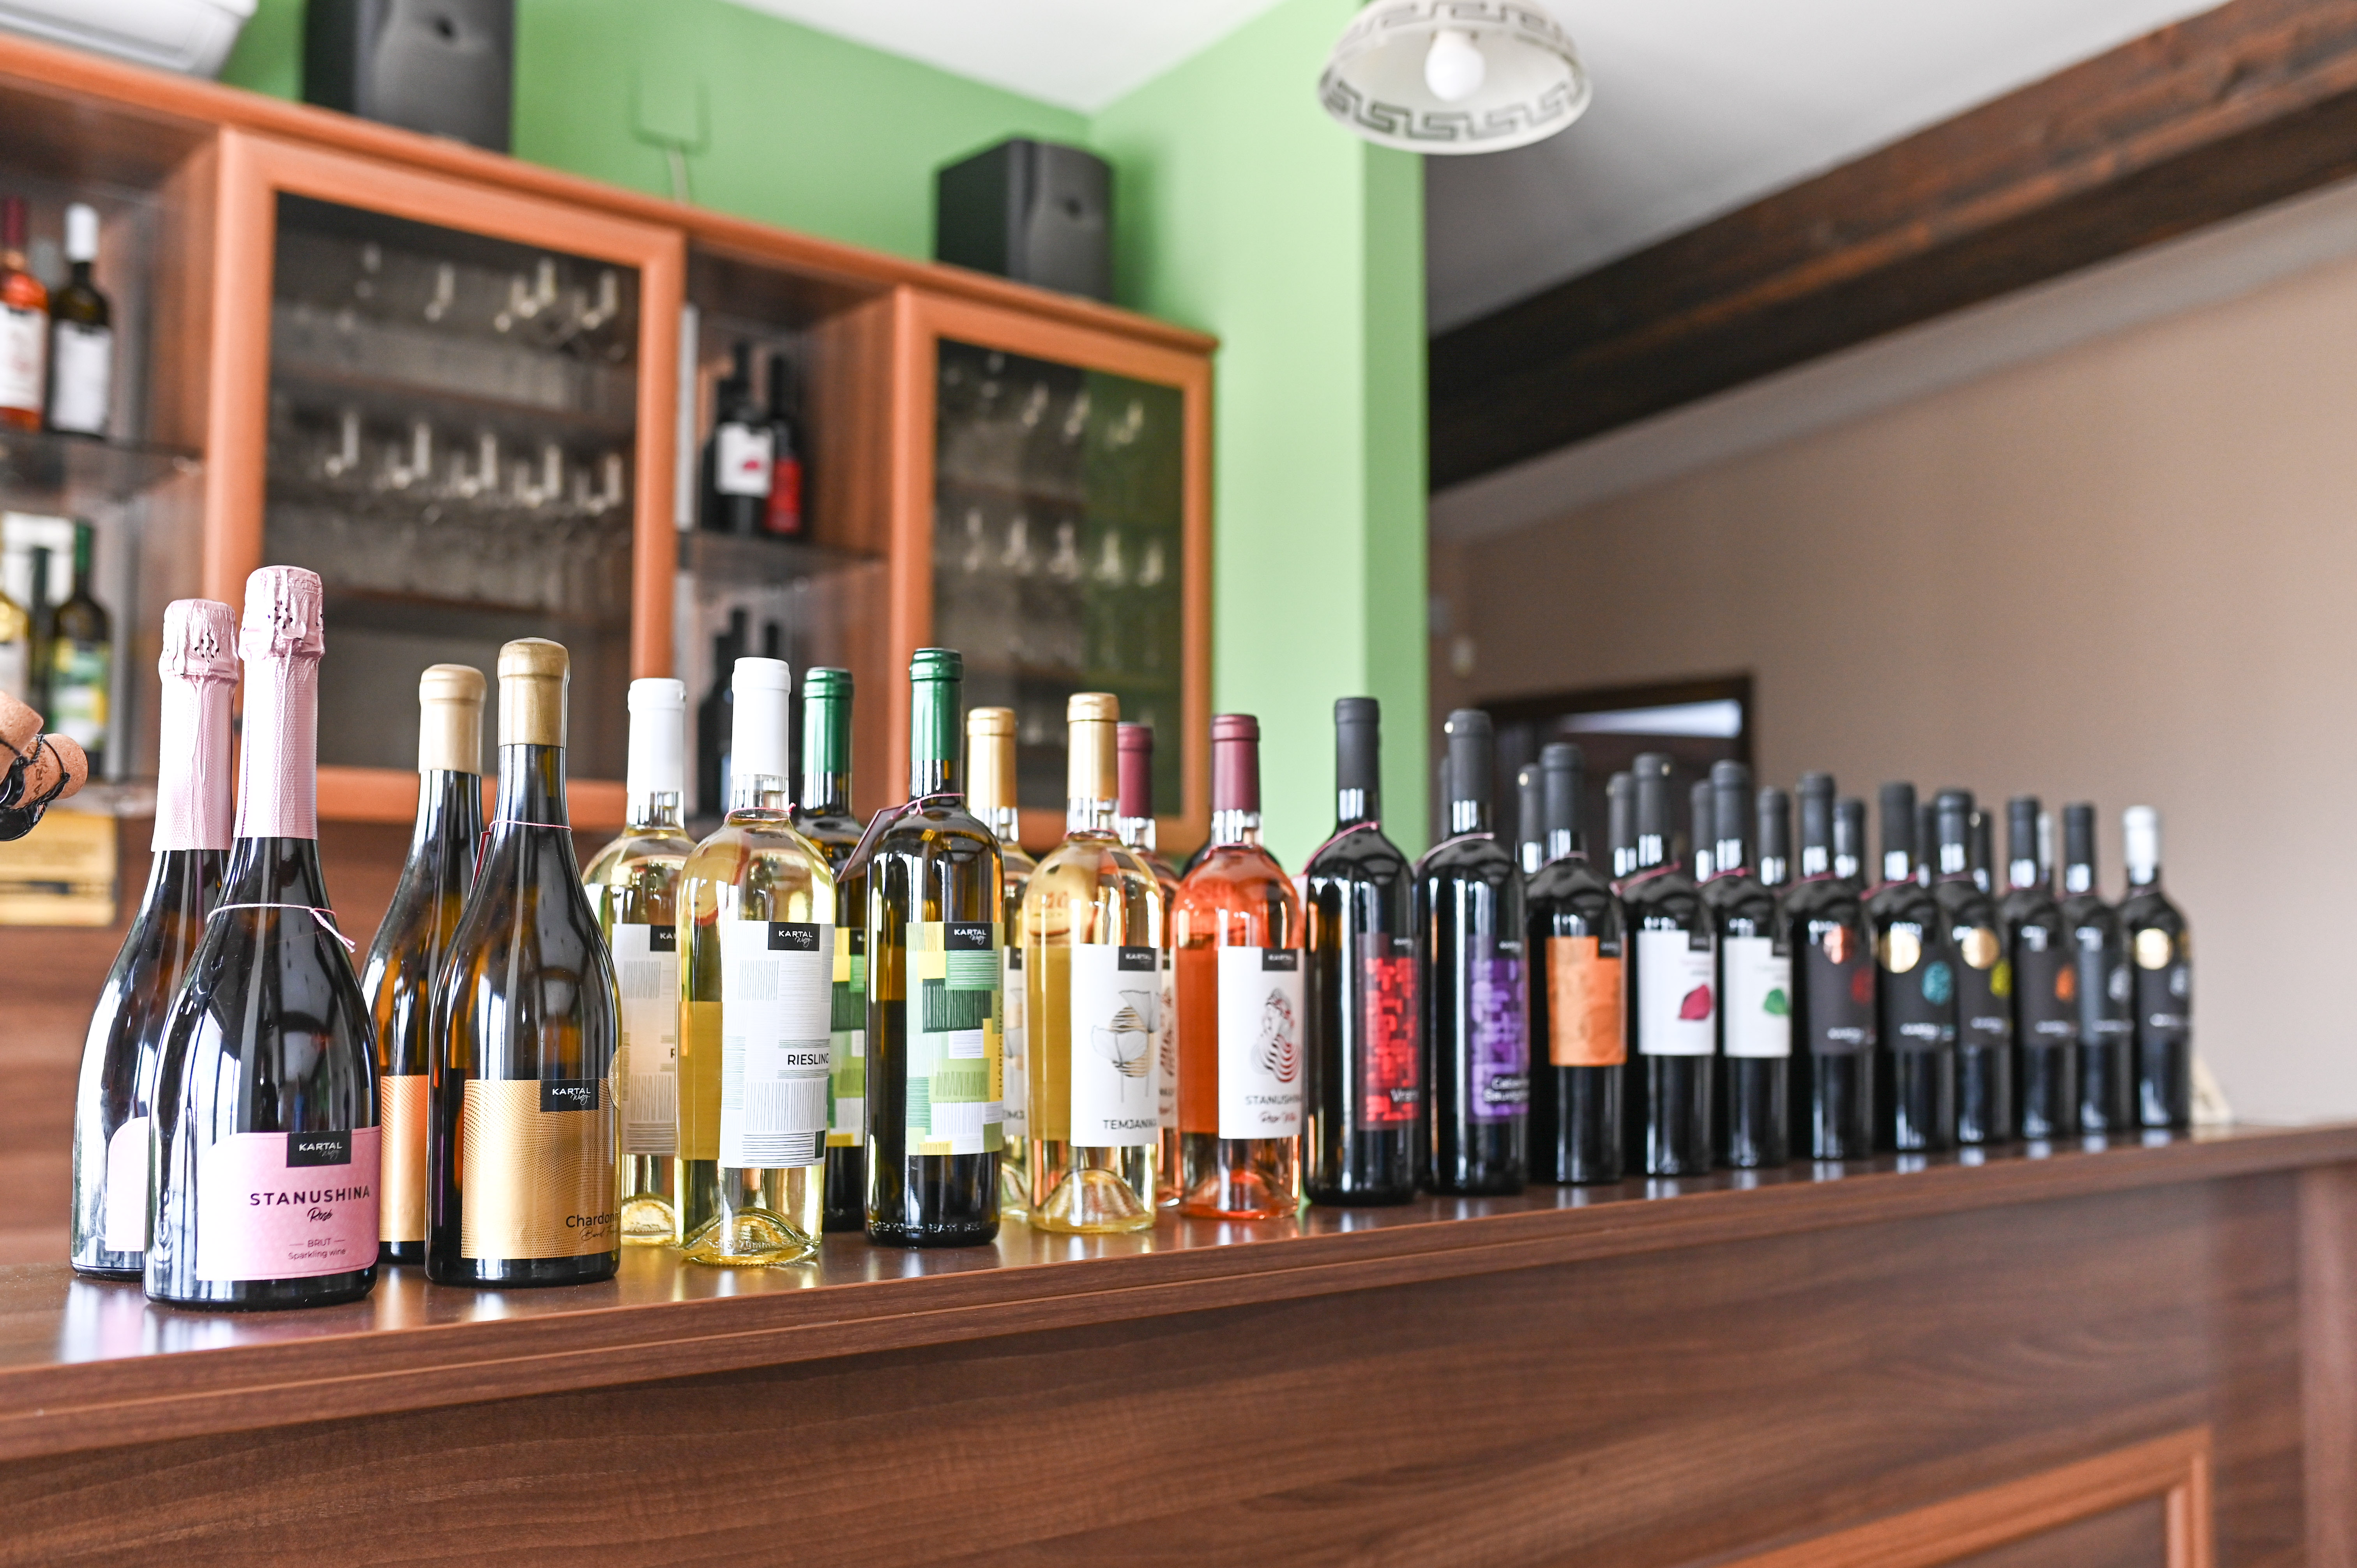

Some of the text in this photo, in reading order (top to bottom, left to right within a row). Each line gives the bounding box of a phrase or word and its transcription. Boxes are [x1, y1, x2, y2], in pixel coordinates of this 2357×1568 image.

[788, 1053, 829, 1065] RIESLING
[552, 1087, 591, 1095] KARTAL
[299, 1142, 343, 1151] KARTAL
[250, 1185, 369, 1206] STANUSHINA
[307, 1238, 331, 1247] BRUT
[288, 1248, 346, 1261] Sparkling wine
